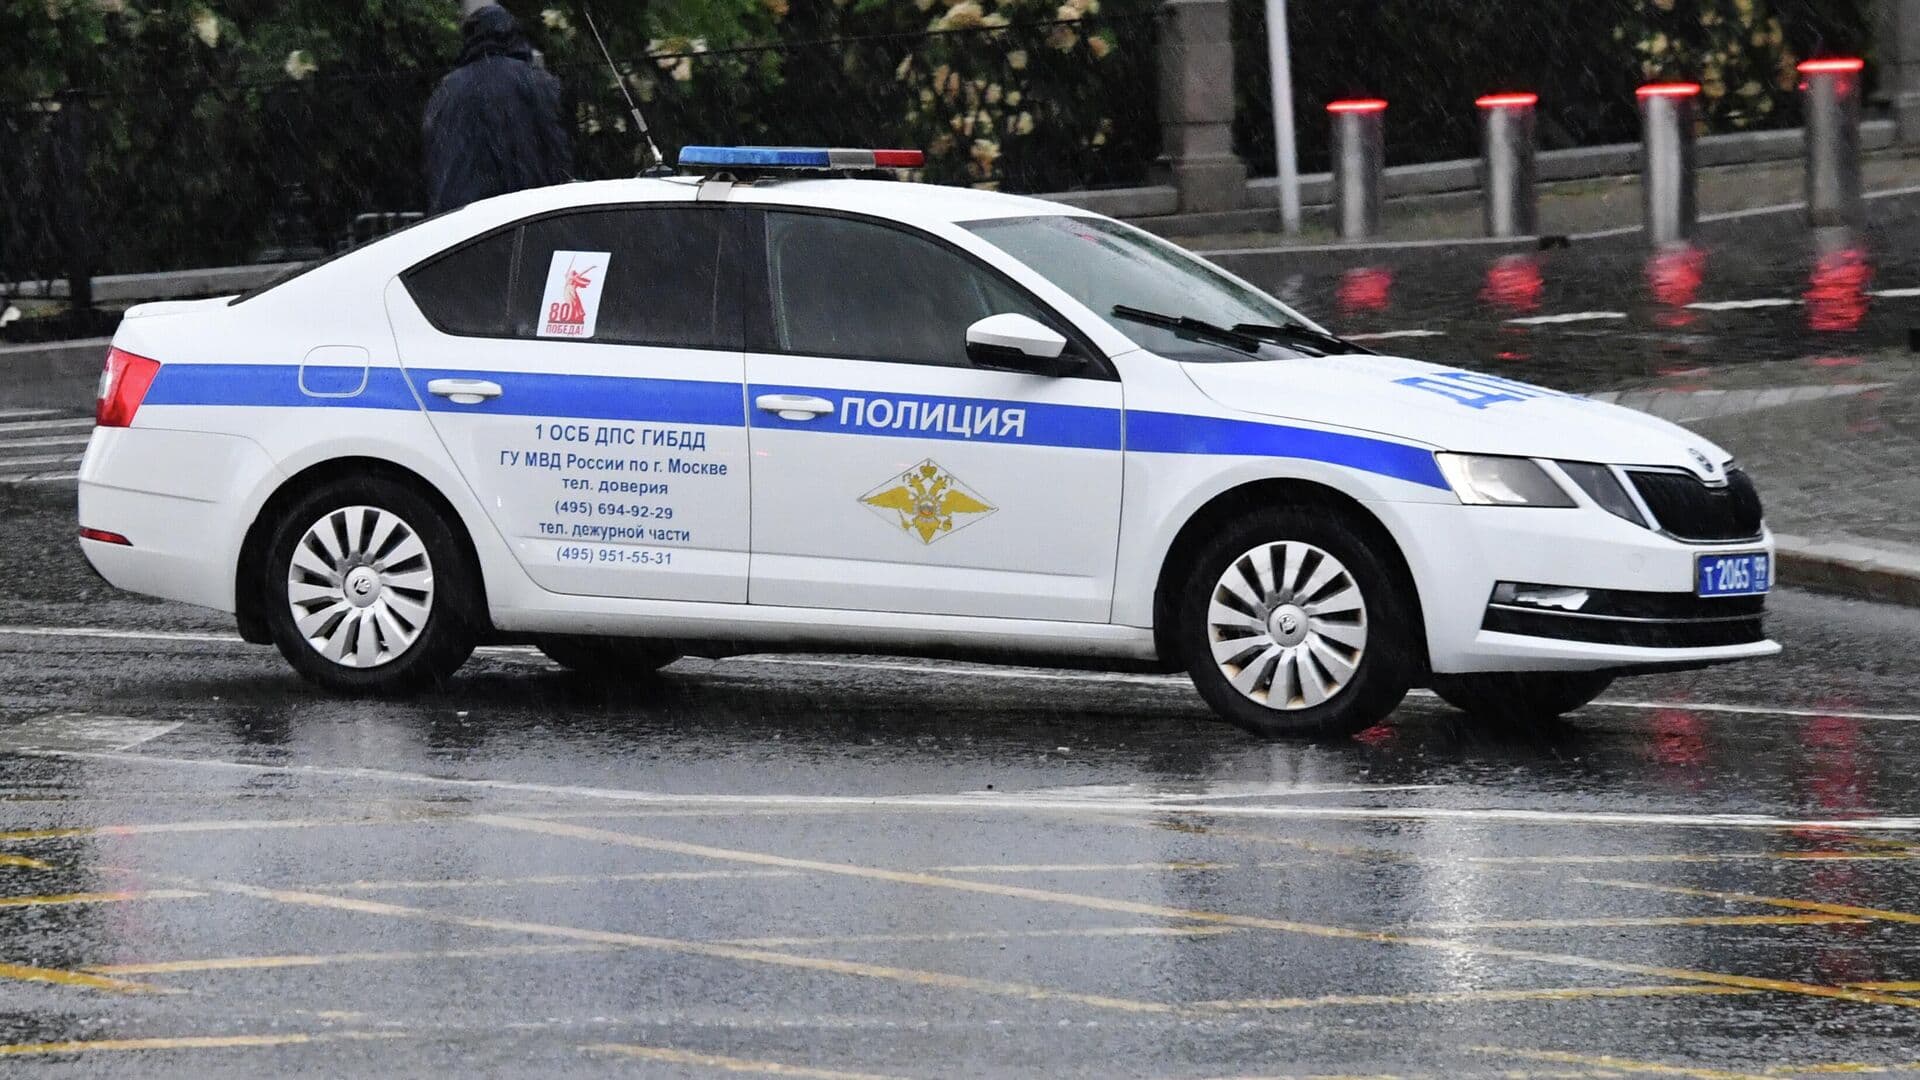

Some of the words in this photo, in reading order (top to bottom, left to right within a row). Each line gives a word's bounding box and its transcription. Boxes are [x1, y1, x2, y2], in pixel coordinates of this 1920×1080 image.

[549, 302, 571, 322] 80
[545, 324, 584, 337] ПОБЕДА!
[840, 397, 1026, 438] ПОЛИЦИЯ
[535, 424, 543, 440] 1
[550, 424, 589, 442] ОСБ
[595, 427, 635, 446] ДПС
[642, 429, 706, 451] ГИБДД
[500, 450, 520, 466] ГУ
[525, 452, 561, 471] МВД
[567, 454, 624, 472] России
[629, 459, 649, 473] по
[653, 461, 663, 473] г.
[668, 458, 728, 476] Москве
[562, 478, 593, 491] тел.
[598, 480, 669, 497] доверия
[554, 500, 593, 517] (495)
[598, 503, 673, 520] 694-92-29
[539, 522, 568, 535] тел.
[572, 523, 644, 541] дежурной
[649, 529, 690, 542] части
[556, 546, 594, 564] (495)
[599, 549, 672, 565] 951-55-31
[1716, 558, 1750, 590] 2065
